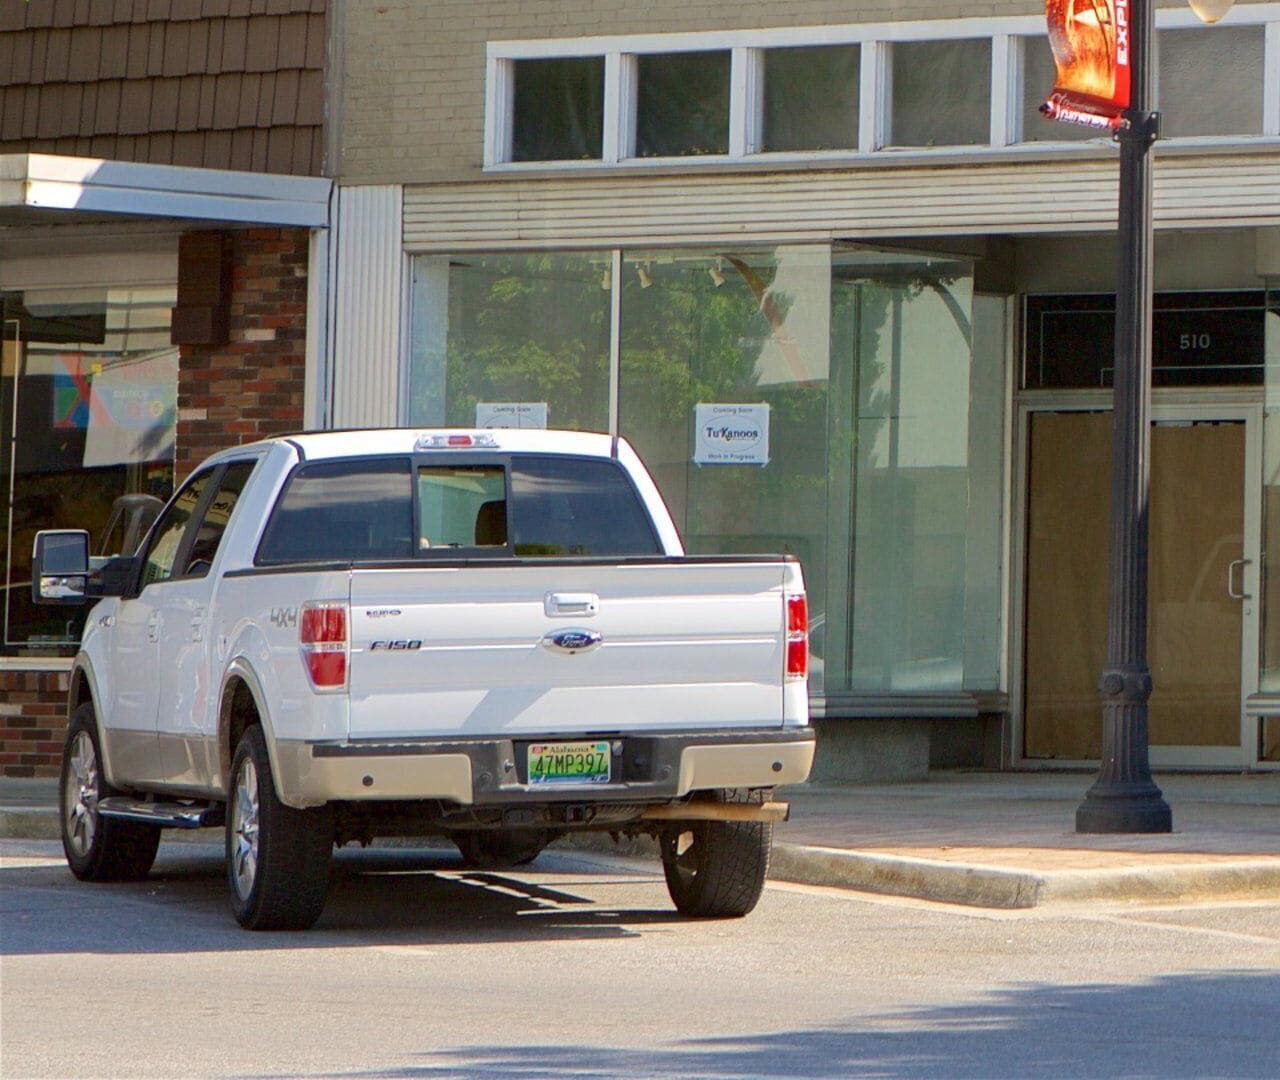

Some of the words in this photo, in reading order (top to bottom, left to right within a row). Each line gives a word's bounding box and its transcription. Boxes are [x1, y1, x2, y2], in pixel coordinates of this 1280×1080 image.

[1180, 334, 1210, 349] 510
[270, 607, 298, 628] 4X4
[560, 635, 588, 648] Ford
[550, 745, 589, 754] Alabama
[535, 753, 605, 775] 47MP397
